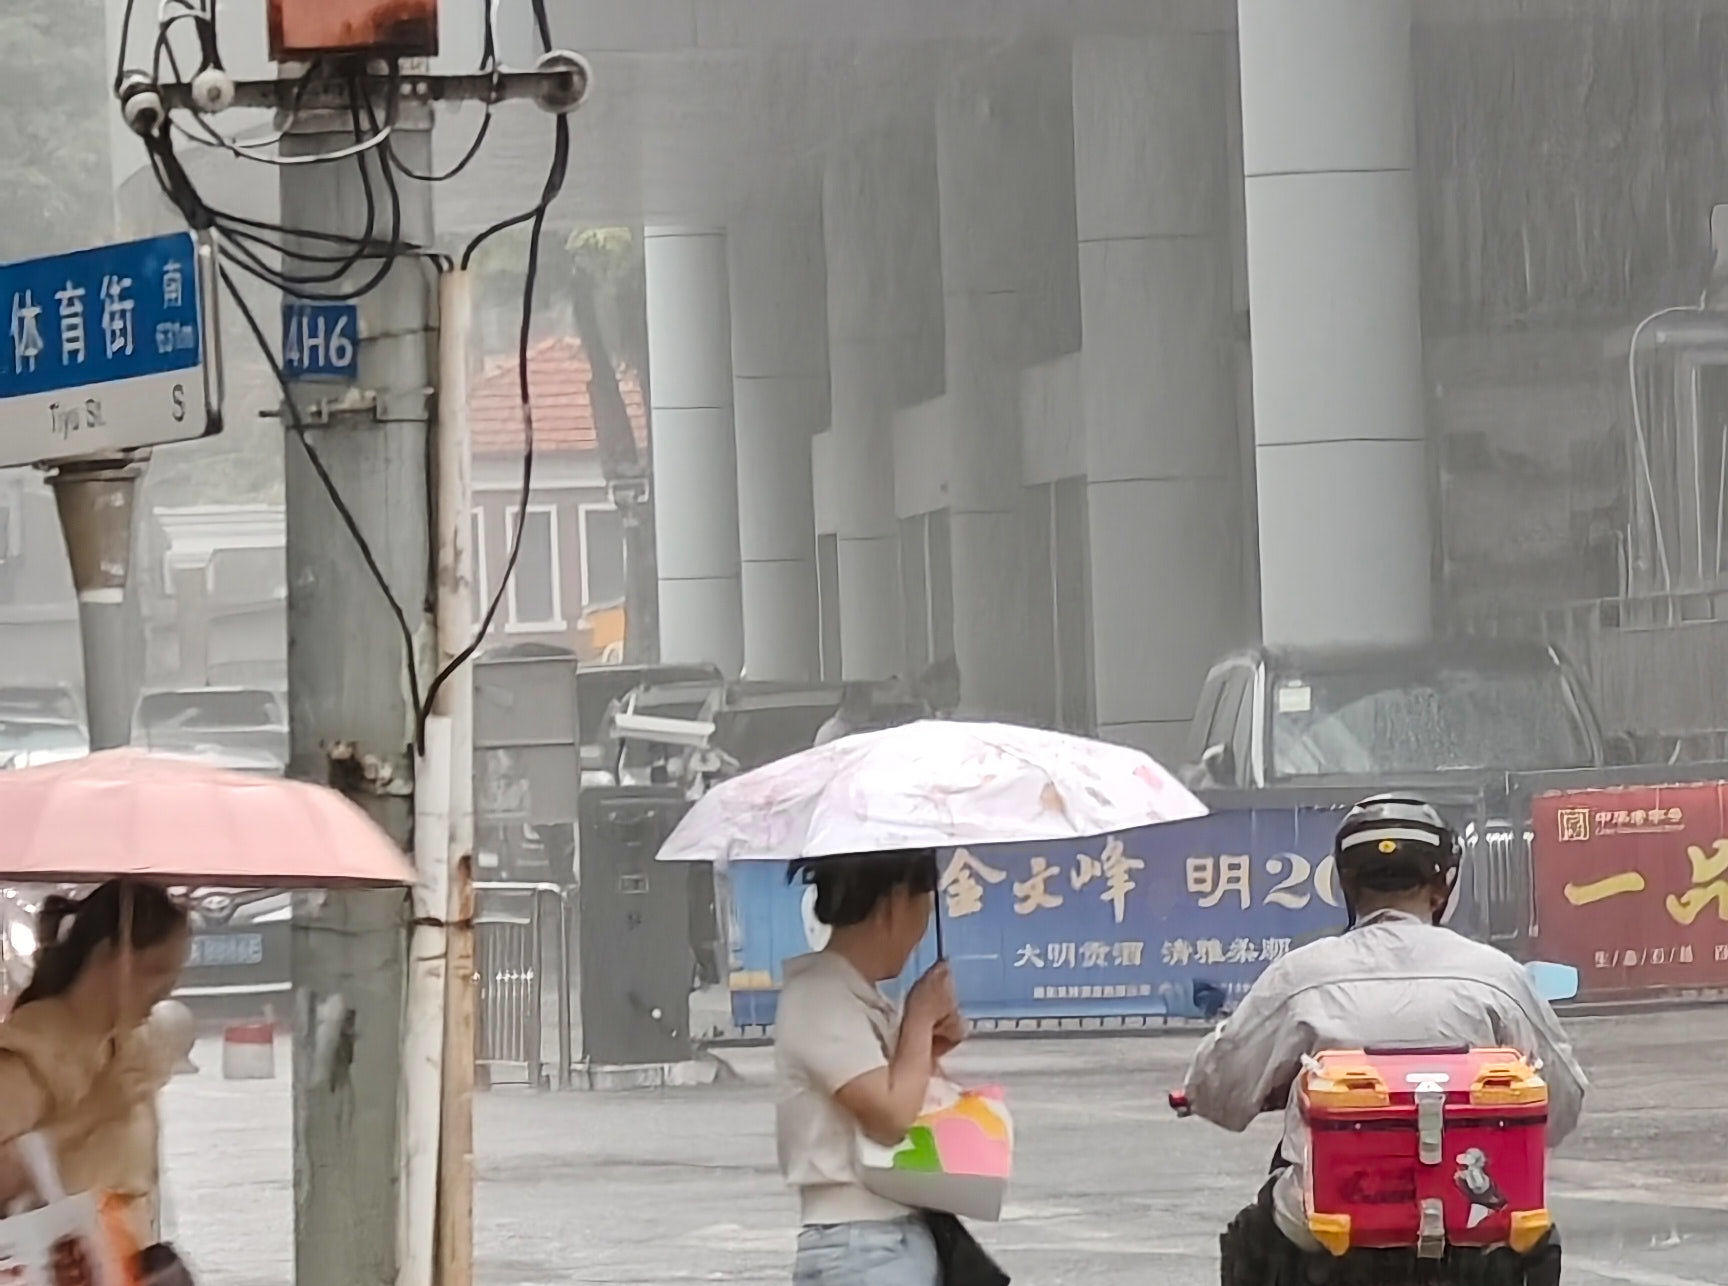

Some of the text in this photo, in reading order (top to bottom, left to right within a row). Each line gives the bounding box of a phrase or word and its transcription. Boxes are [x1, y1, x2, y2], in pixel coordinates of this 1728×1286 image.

[9, 274, 135, 375] 体育街
[285, 314, 353, 369] 4H6
[172, 384, 185, 422] S
[939, 835, 1145, 924] 金文峰
